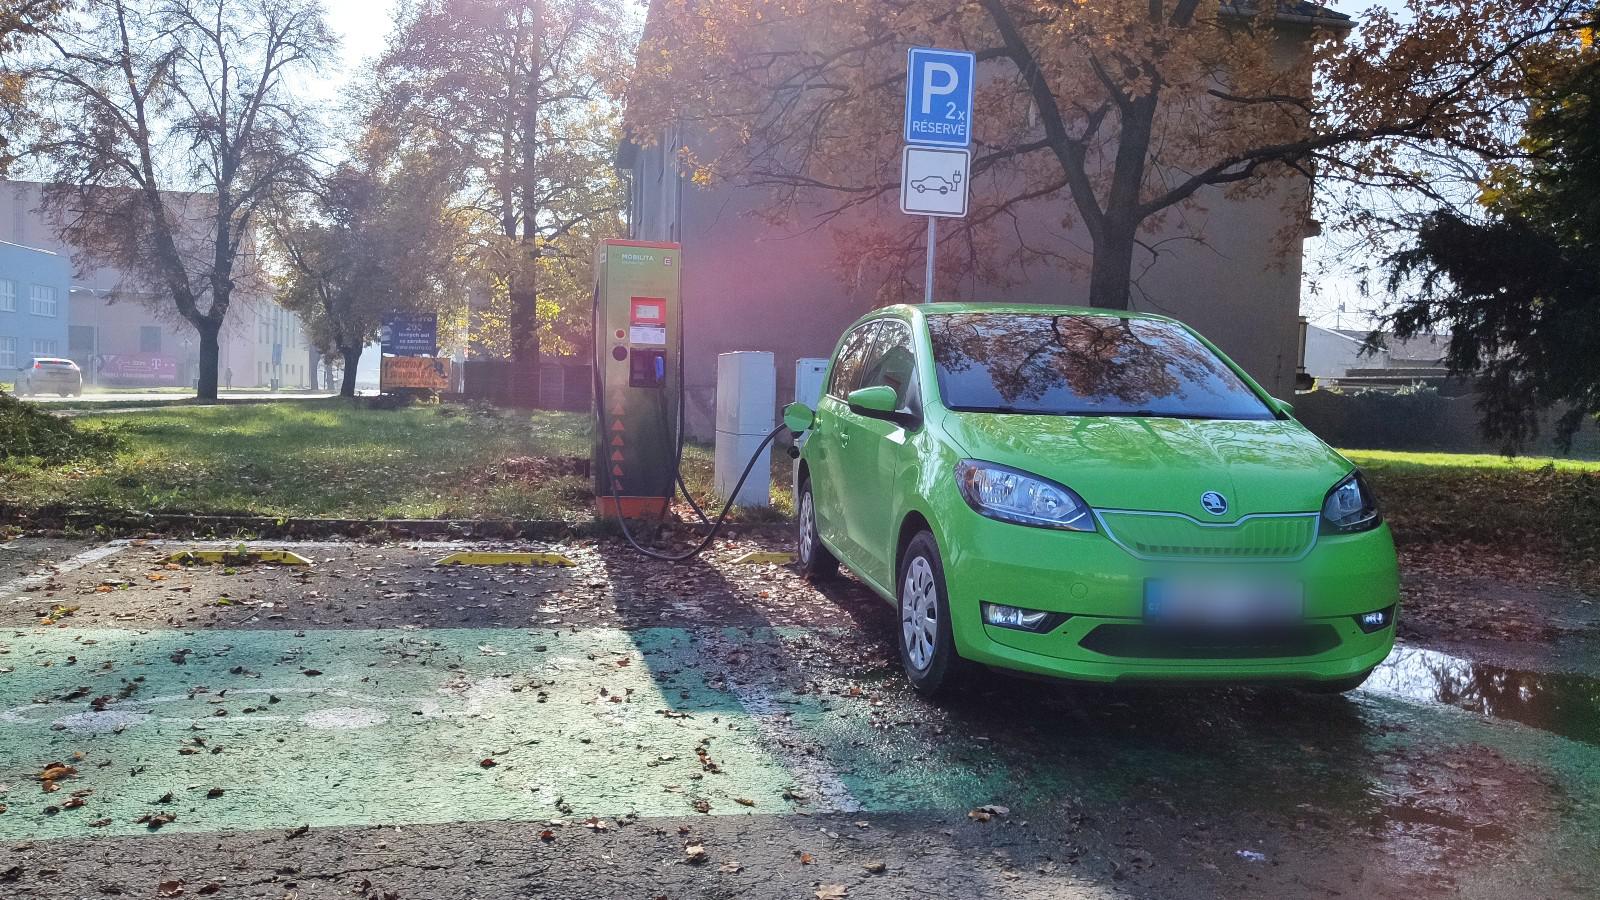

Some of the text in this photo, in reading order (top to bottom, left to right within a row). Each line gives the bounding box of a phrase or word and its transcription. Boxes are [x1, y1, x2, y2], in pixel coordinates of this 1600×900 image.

[921, 61, 959, 114] P
[945, 101, 965, 121] 2x
[912, 119, 966, 136] RÉSERVÉ
